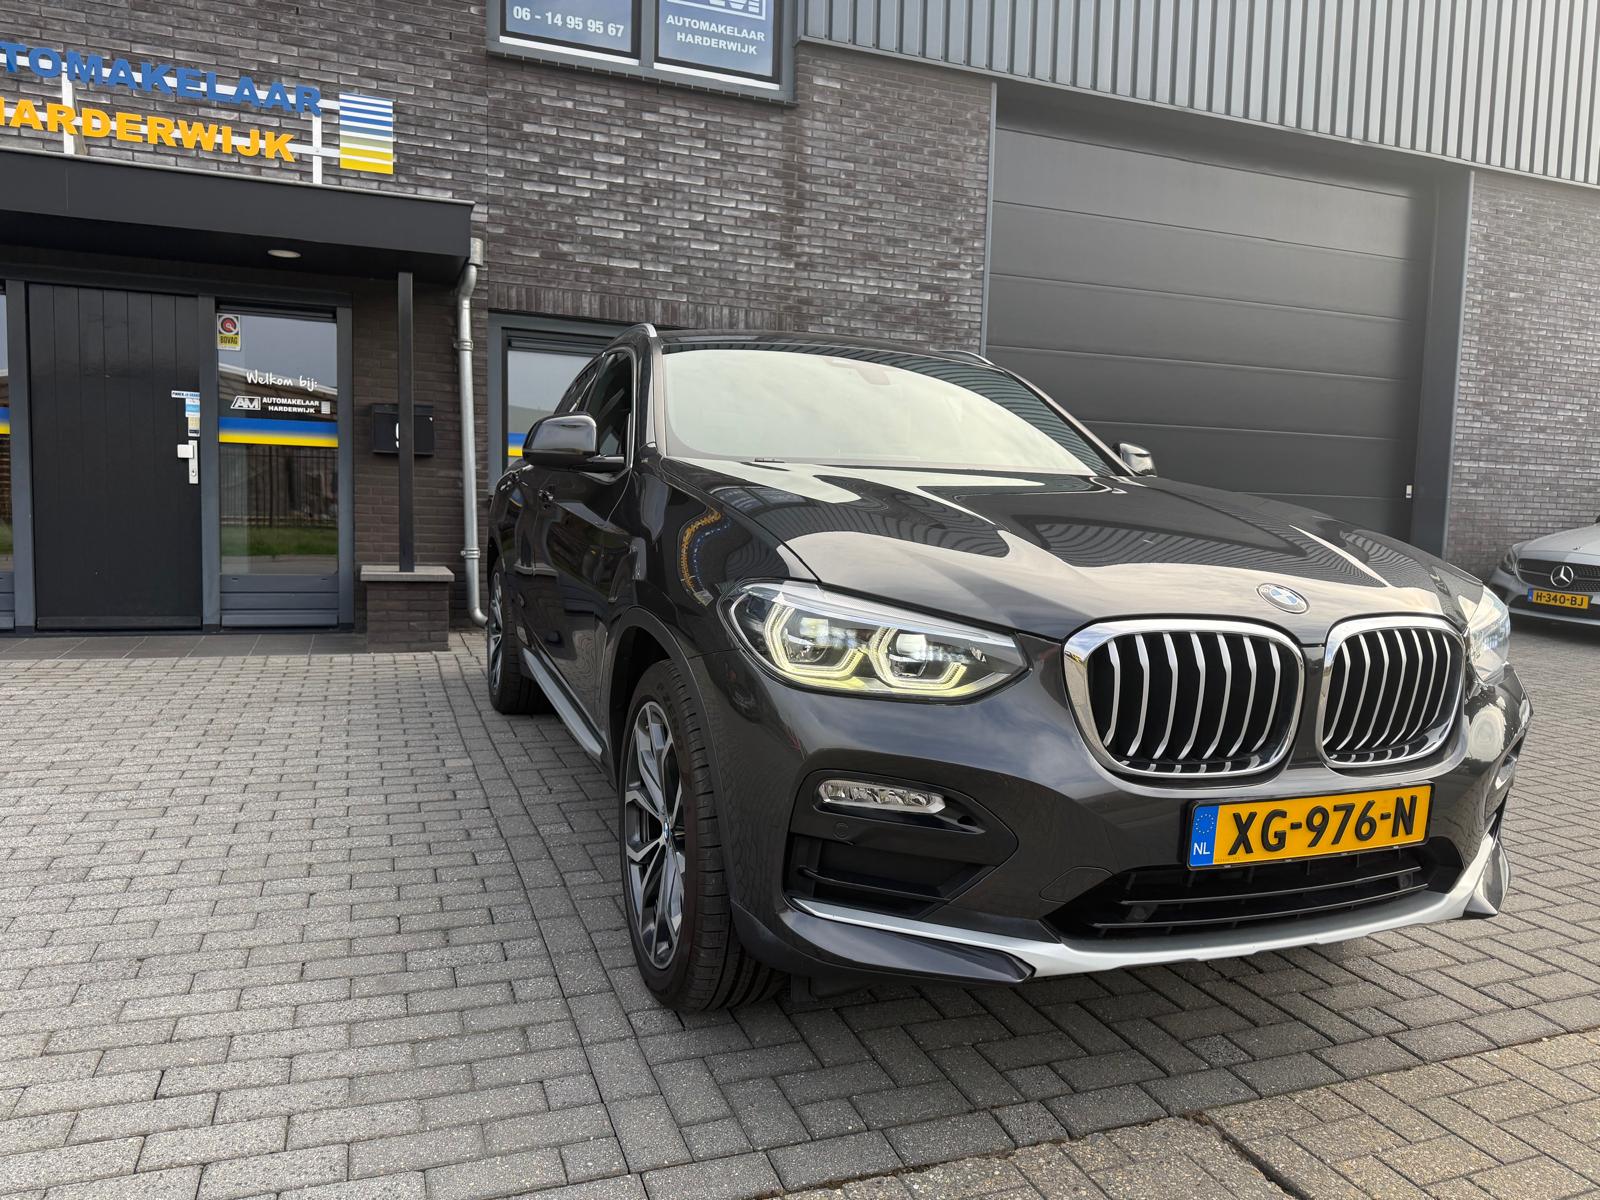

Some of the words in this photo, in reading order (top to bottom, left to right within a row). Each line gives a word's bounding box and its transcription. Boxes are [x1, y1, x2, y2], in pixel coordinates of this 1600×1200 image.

[513, 6, 531, 21] 06
[545, 11, 562, 26] 14
[566, 15, 583, 30] 95
[587, 19, 604, 34] 95
[607, 22, 624, 37] 67
[666, 14, 765, 41] AUTOMAKELAAR
[676, 31, 757, 55] HARDERWIJK
[0, 96, 296, 162] ARDERWIJK
[220, 335, 238, 345] BOVAG
[246, 369, 293, 387] Welkom
[299, 376, 318, 392] bij:
[262, 396, 320, 406] AUTOMAKELAAR
[268, 405, 315, 413] HARDERWIJK
[1535, 591, 1584, 607] H-340-BJ
[1227, 795, 1418, 856] XG-976-N
[1193, 841, 1211, 856] NL
